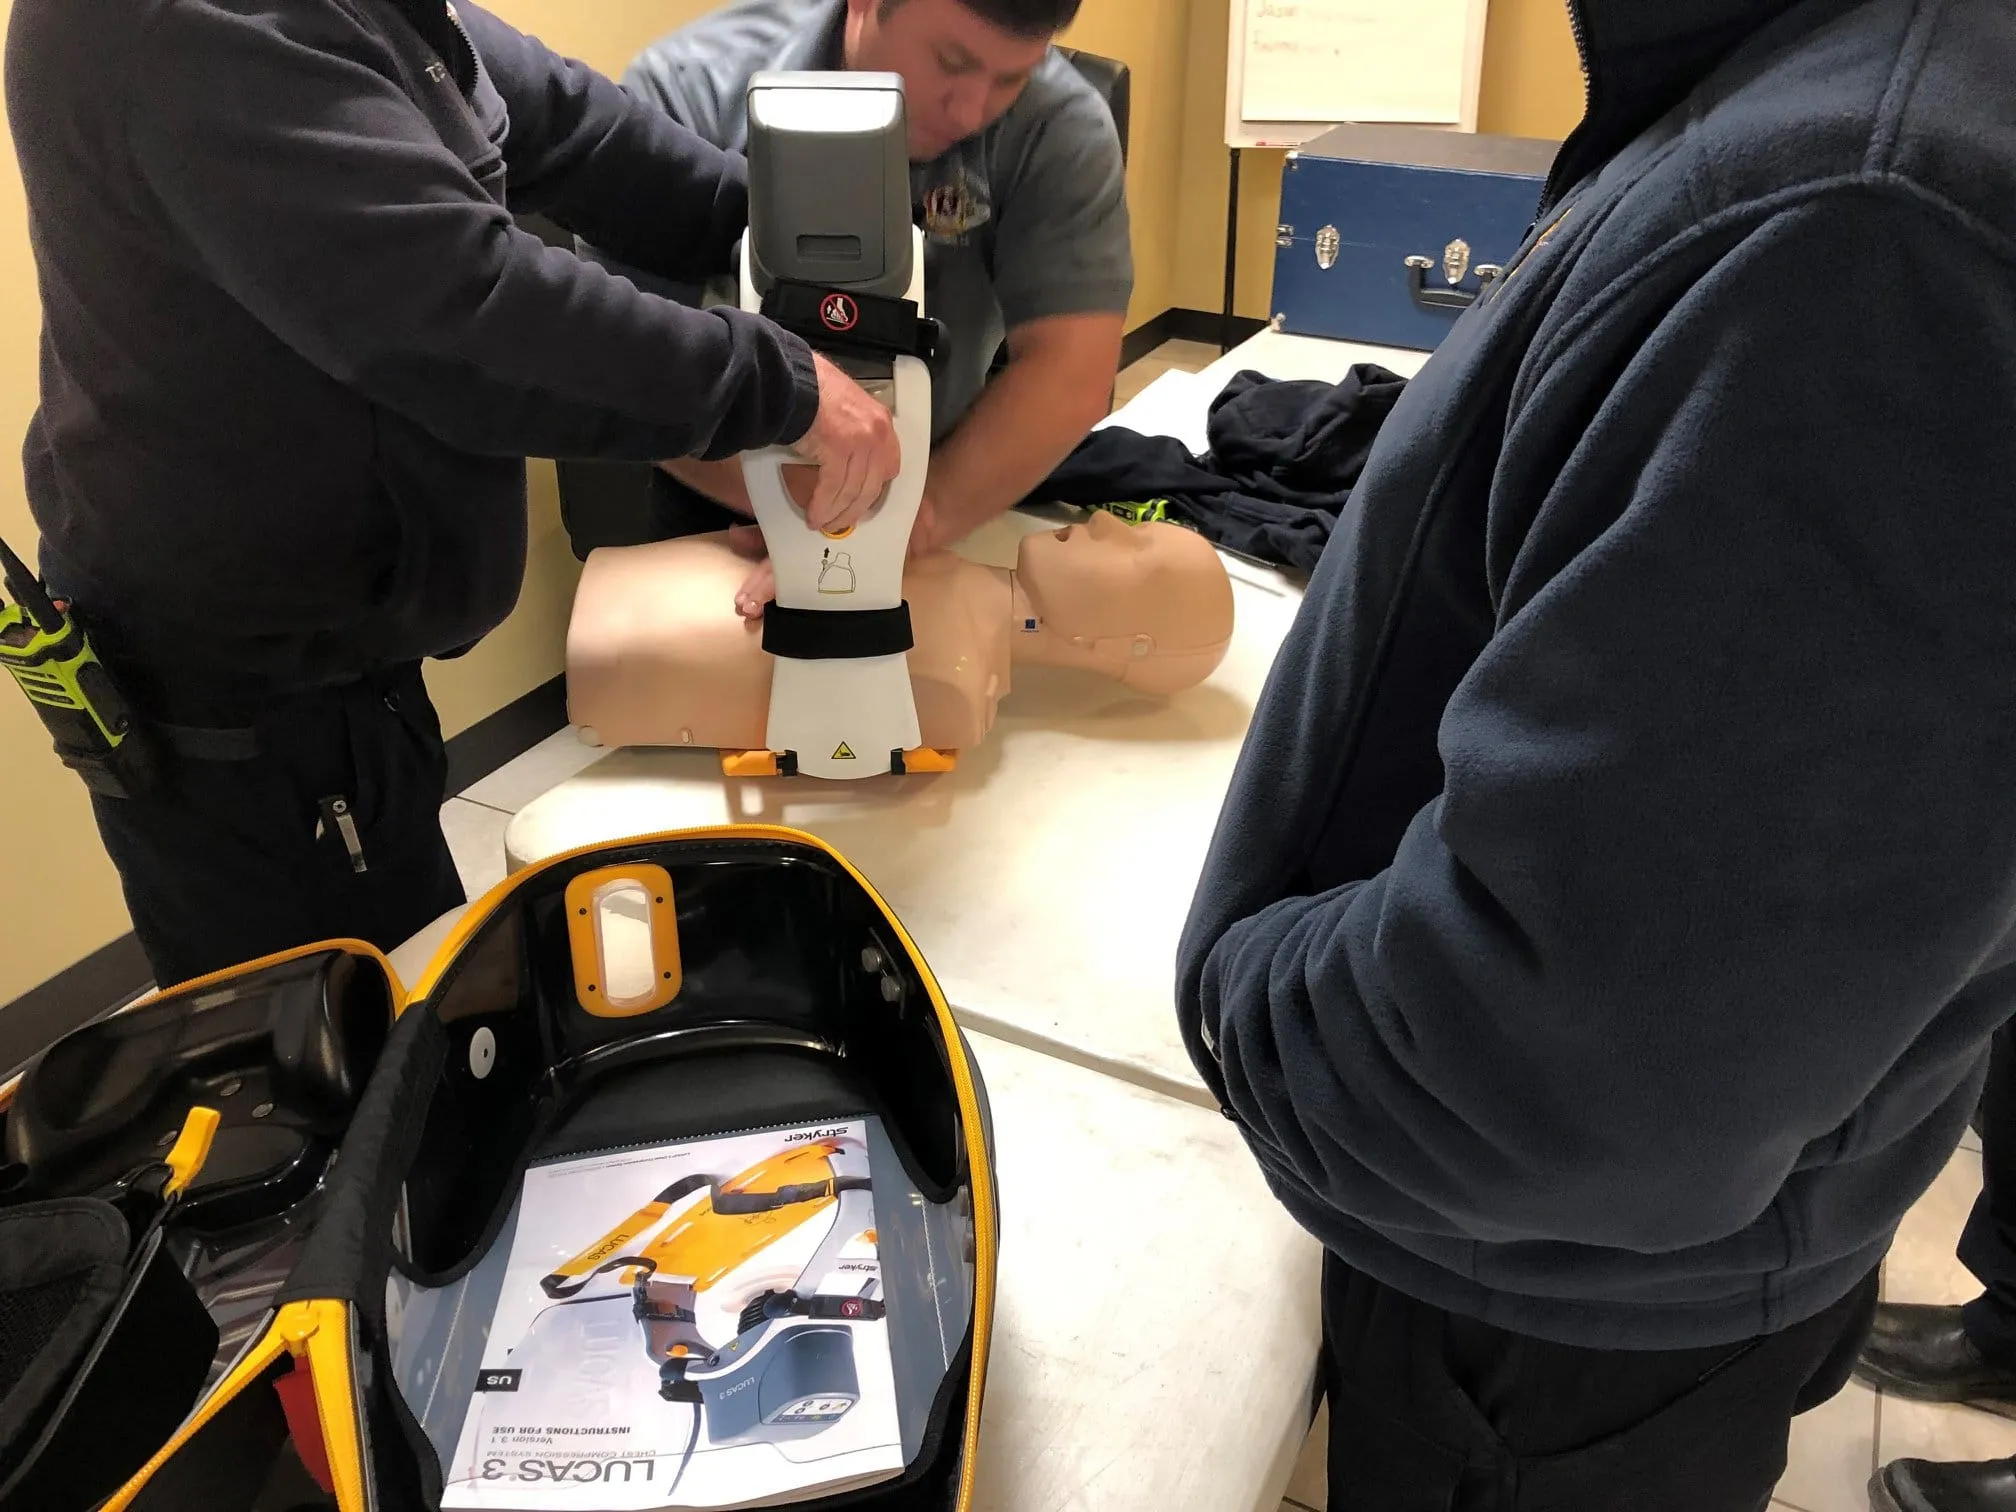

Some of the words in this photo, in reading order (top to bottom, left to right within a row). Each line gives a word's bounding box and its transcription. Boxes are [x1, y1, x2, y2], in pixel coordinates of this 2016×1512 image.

[784, 1127, 848, 1142] stryker
[587, 1234, 628, 1260] LUCAS
[838, 1264, 878, 1272] stryker
[486, 1375, 512, 1385] US
[726, 1376, 755, 1396] LUCAS
[718, 1390, 725, 1400] 3
[492, 1426, 515, 1434] USE
[518, 1426, 542, 1434] FOR
[546, 1426, 630, 1435] INSTRUCTIONS
[512, 1436, 552, 1445] Version
[486, 1450, 532, 1458] SYSTEM
[535, 1450, 616, 1459] COMPRESSION
[482, 1458, 506, 1481] 3
